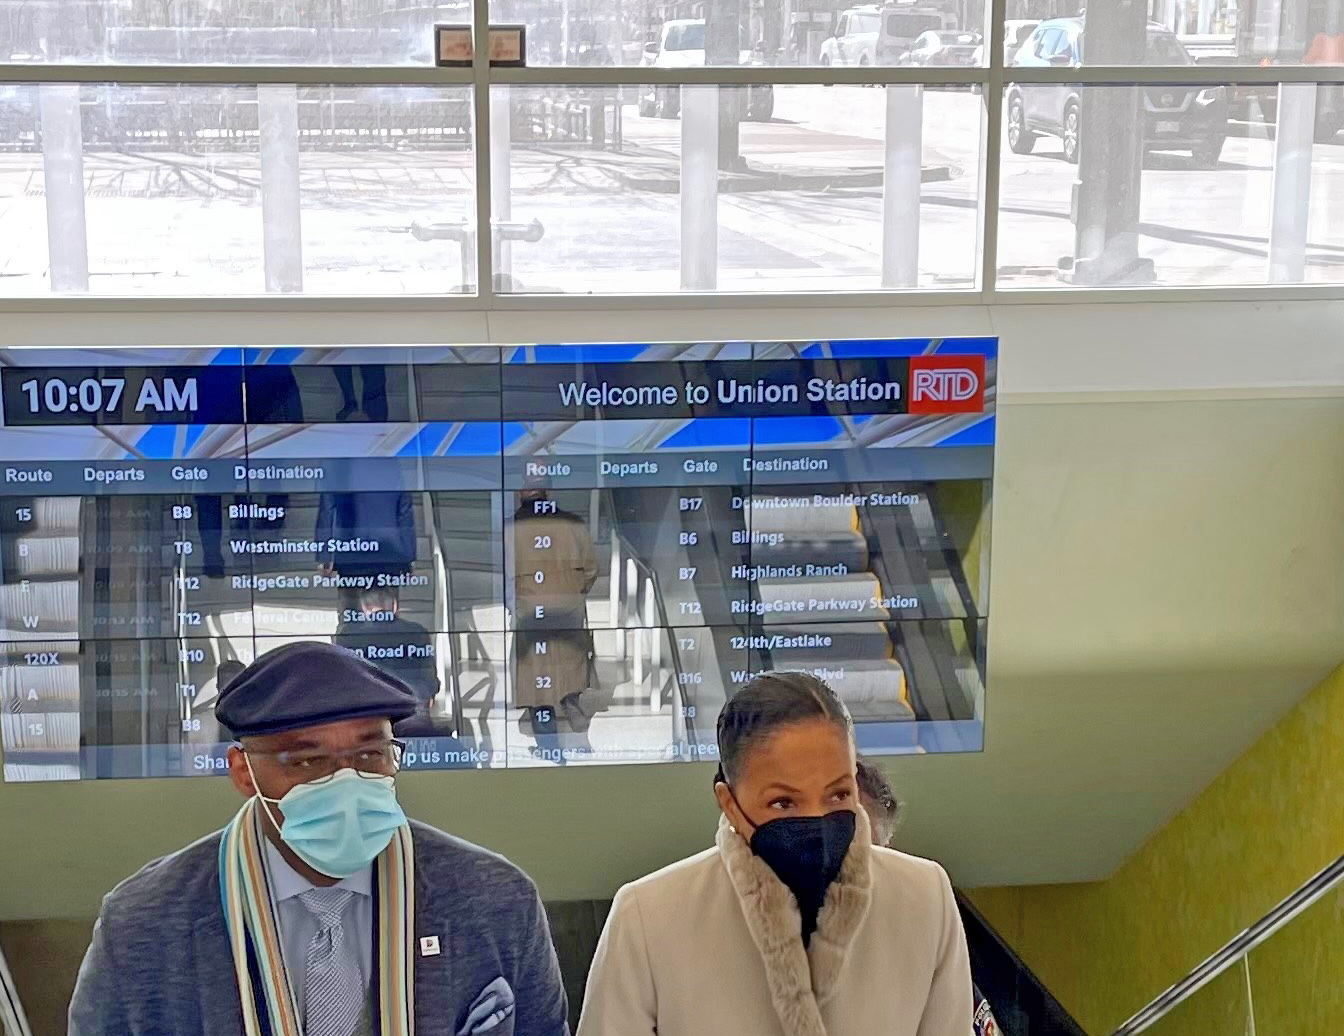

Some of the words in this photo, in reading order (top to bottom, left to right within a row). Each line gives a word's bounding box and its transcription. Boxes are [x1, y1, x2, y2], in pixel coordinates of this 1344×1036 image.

[20, 379, 127, 413] 10:07
[134, 377, 199, 411] AM
[558, 381, 678, 407] Welcome
[684, 383, 710, 405] to
[717, 379, 798, 403] Union
[805, 376, 901, 402] Station
[912, 368, 978, 402] RTD
[5, 467, 53, 483] Route
[83, 466, 145, 484] Departs
[171, 466, 209, 482] Gate
[234, 464, 324, 480] Destination
[526, 462, 571, 476] Route
[600, 461, 658, 477] Departs
[683, 459, 718, 473] Gate
[743, 456, 828, 472] Destination
[15, 508, 32, 522] 15
[172, 505, 193, 520] B8
[228, 503, 285, 521] Billings
[533, 500, 557, 514] FF1
[679, 497, 703, 511] B17
[731, 496, 810, 511] Downtown
[813, 493, 866, 508] Boulder
[869, 492, 920, 506] Station
[18, 544, 29, 557] B
[173, 541, 194, 556] T8
[230, 538, 325, 554] Westminster
[327, 537, 380, 552] Station
[533, 536, 551, 549] 20
[679, 532, 698, 546] B6
[731, 531, 785, 547] Billings
[232, 574, 310, 591] RidgeGate
[313, 573, 374, 591] Parkway
[377, 572, 429, 587] Station
[679, 567, 697, 580] B7
[731, 565, 803, 581] Highlands
[806, 563, 848, 577] Ranch
[535, 605, 545, 619] E
[679, 601, 703, 615] T12
[731, 599, 805, 615] RidgeGate
[808, 597, 866, 613] Parkway
[869, 595, 919, 609] Station
[22, 615, 39, 628] W
[177, 612, 202, 626] T12
[343, 608, 395, 623] Station
[535, 641, 547, 655] N
[679, 637, 695, 650] T2
[730, 634, 833, 651] 124th/Eastlake
[24, 651, 60, 666] 120X
[367, 644, 404, 659] Road
[407, 644, 435, 658] PnR
[535, 676, 552, 689] 32
[679, 672, 702, 685] B16
[28, 688, 39, 700] A
[180, 684, 197, 697] T1
[535, 710, 551, 723] 15
[28, 723, 44, 736] 15
[182, 719, 201, 732] B8
[420, 752, 441, 765] us
[444, 748, 489, 764] make
[687, 743, 720, 758] nee
